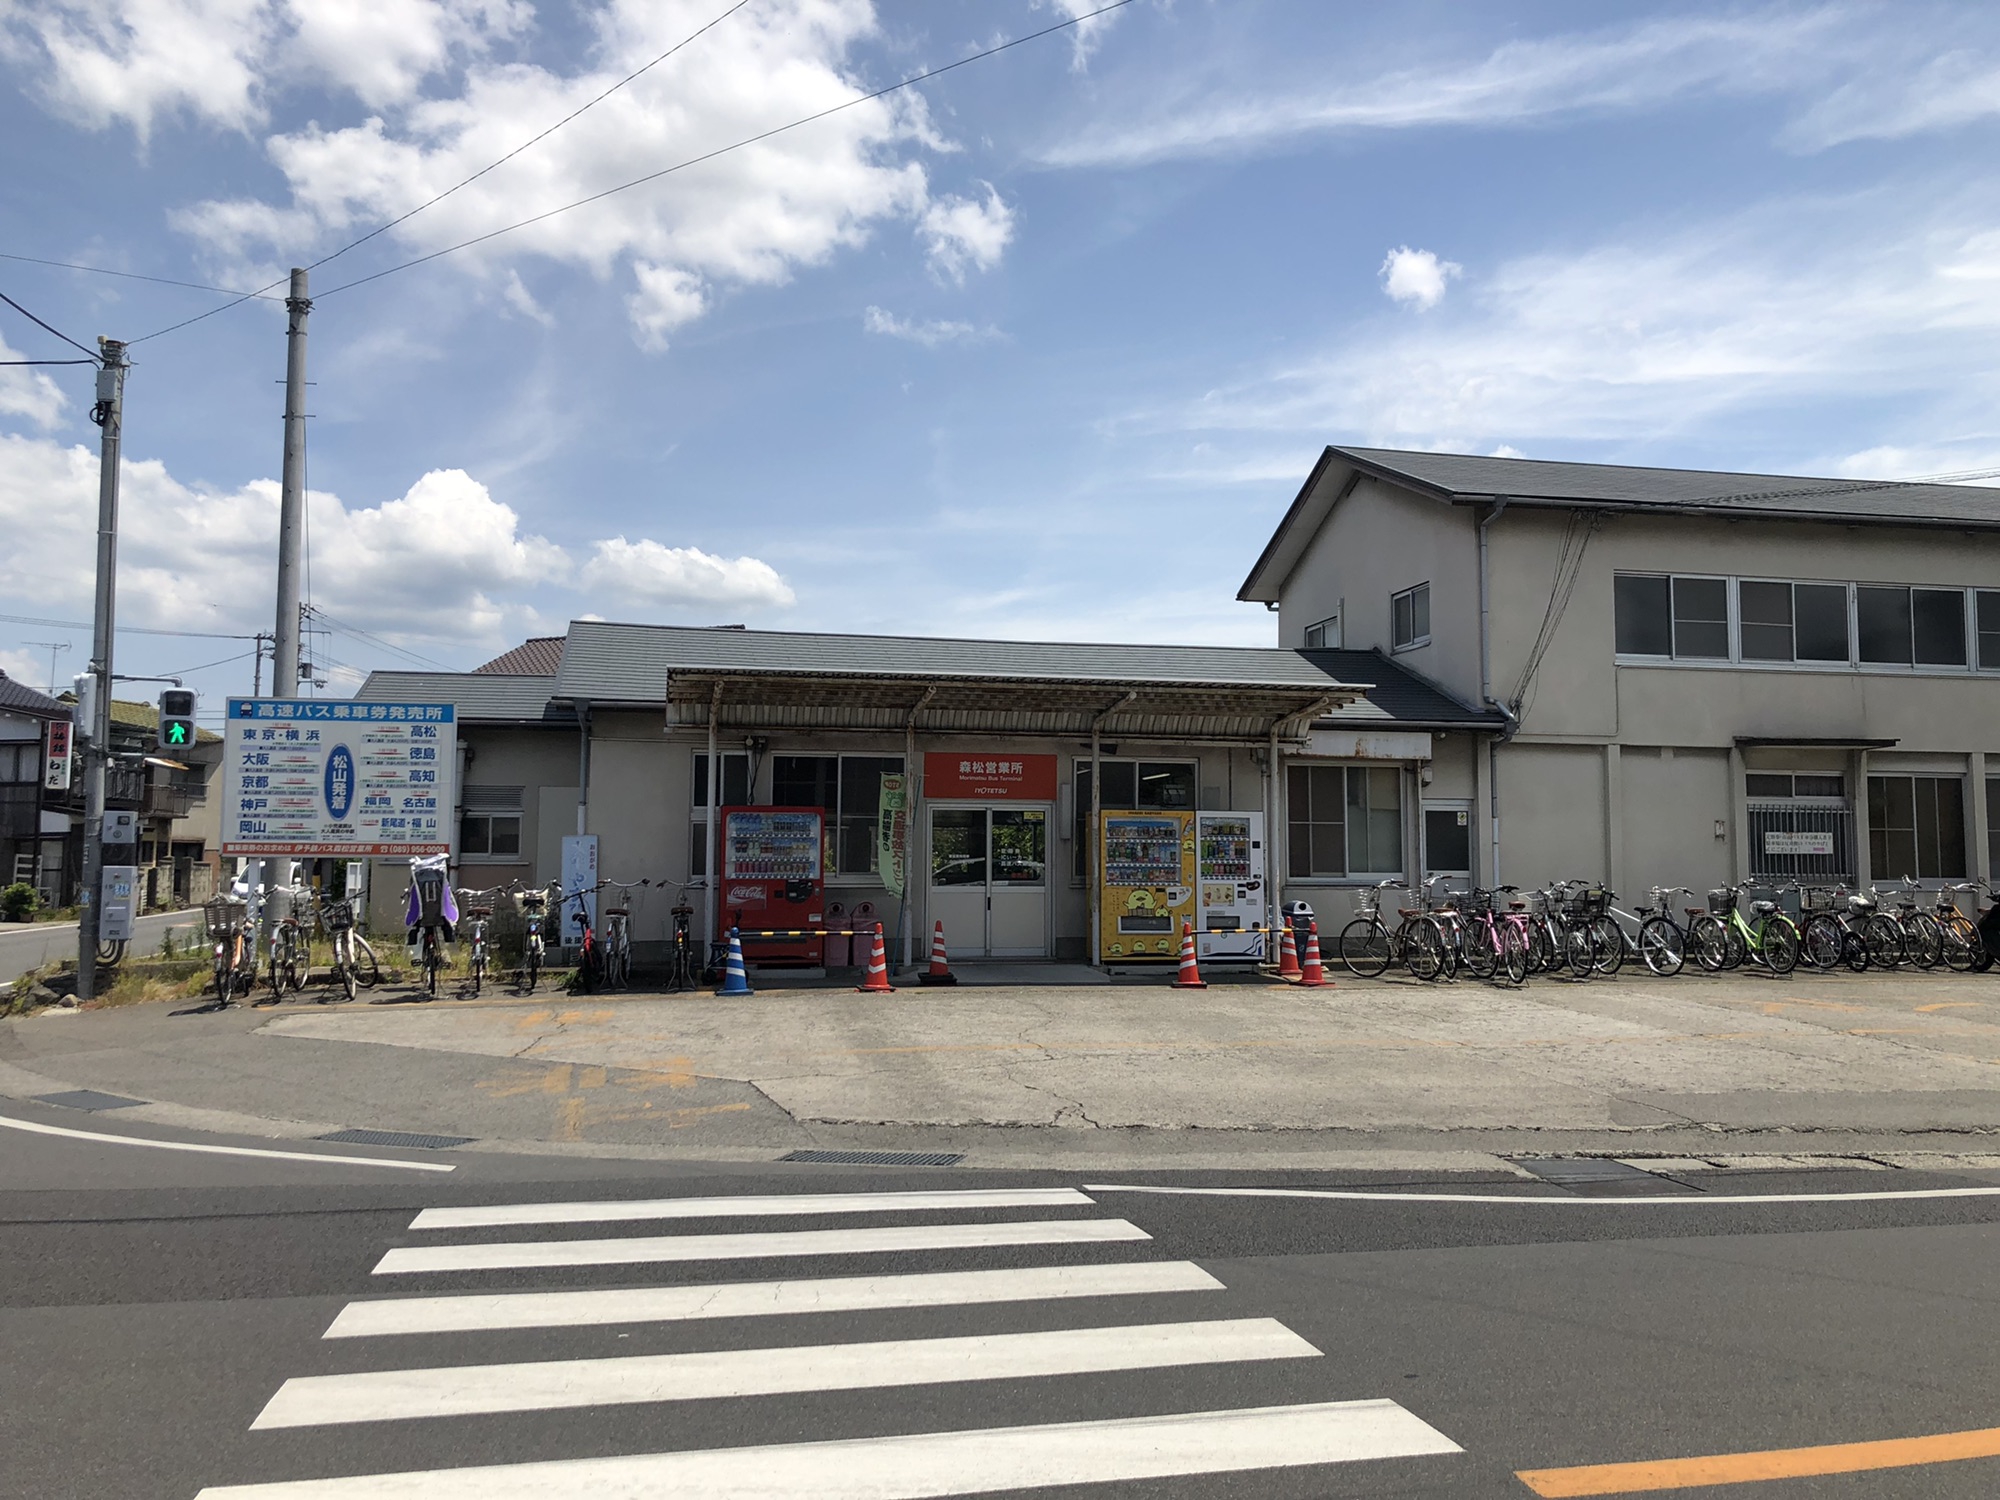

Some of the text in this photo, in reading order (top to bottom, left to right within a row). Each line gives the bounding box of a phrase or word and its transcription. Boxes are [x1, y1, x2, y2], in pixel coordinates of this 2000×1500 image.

[258, 703, 443, 720] 高速バス乗車券発売所
[410, 725, 437, 738] 高松
[242, 752, 270, 766] 大阪
[409, 746, 436, 760] 徳島
[959, 761, 1023, 775] 森松営業所
[241, 775, 269, 789] 京都
[332, 755, 348, 810] 松山発着
[408, 769, 435, 783] 高知
[974, 787, 1008, 795] IYOTETSU
[240, 797, 268, 811] 神戸
[364, 796, 392, 806] 福岡
[402, 797, 437, 808] 名古屋
[239, 820, 267, 834] 岡山
